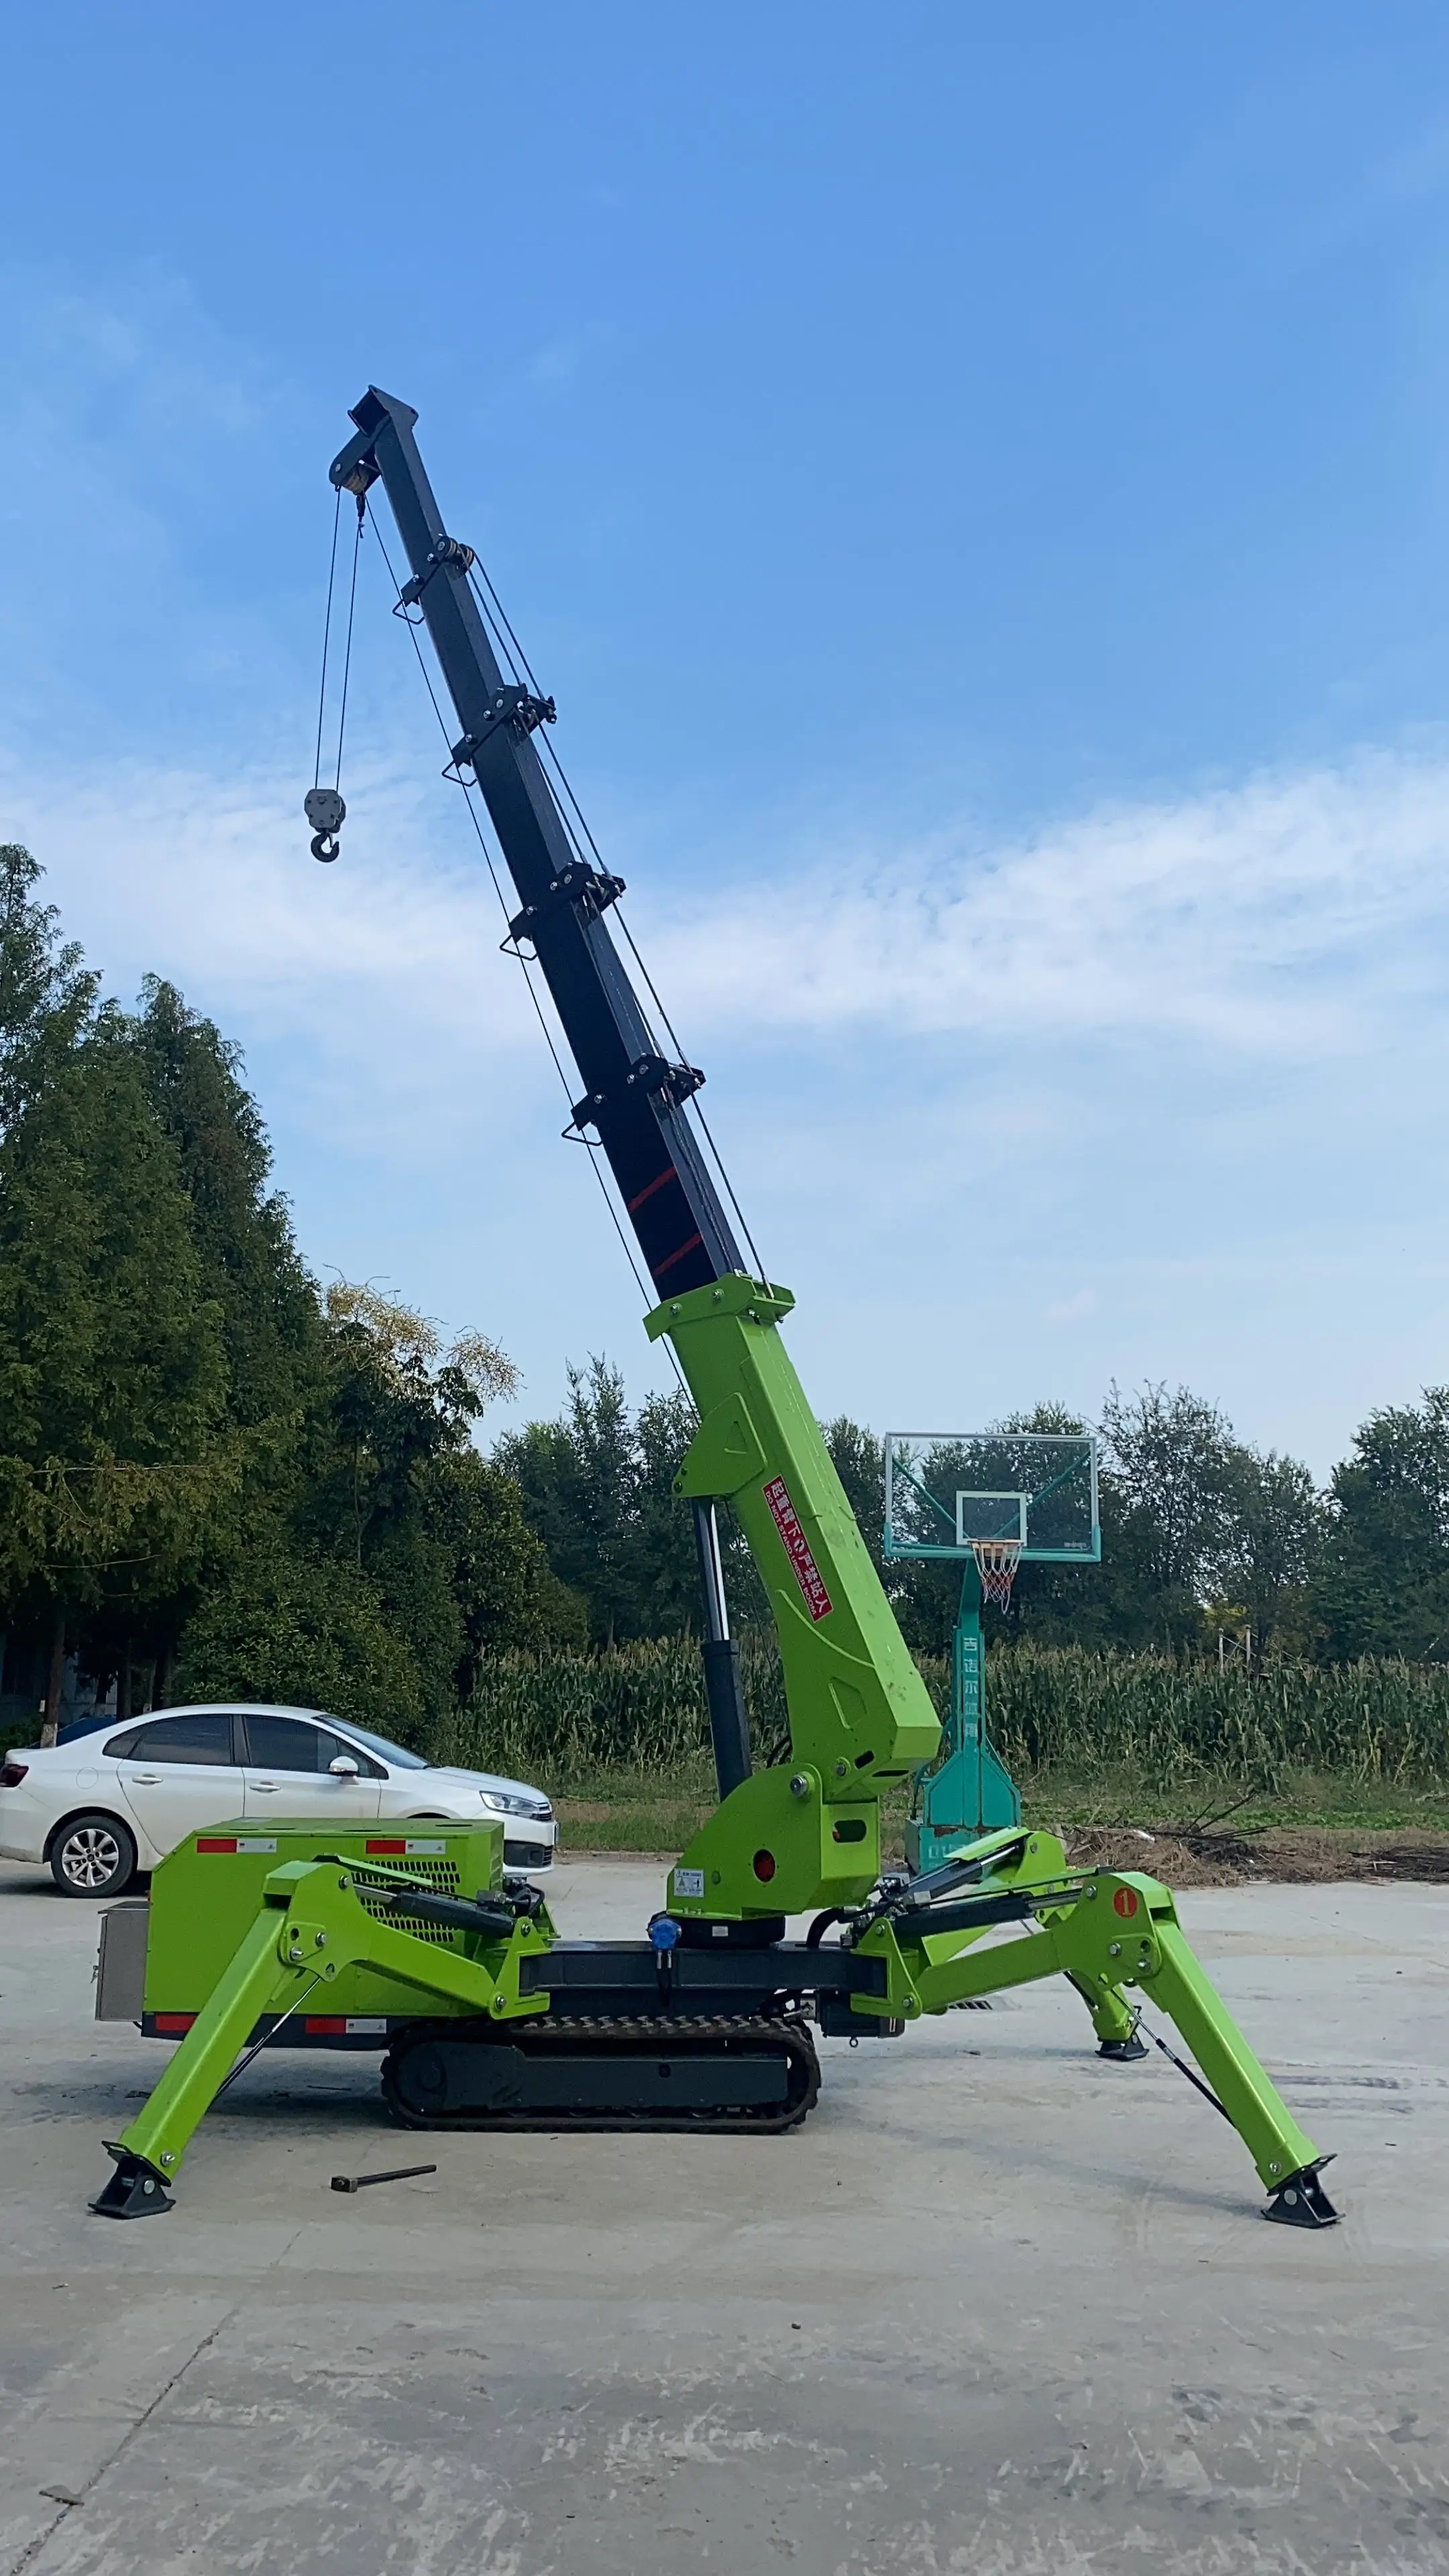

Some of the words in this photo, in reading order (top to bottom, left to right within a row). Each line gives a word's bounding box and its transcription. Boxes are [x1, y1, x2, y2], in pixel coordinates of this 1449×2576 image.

[766, 1491, 773, 1504] DO
[771, 1505, 782, 1523] NOT
[779, 1525, 792, 1554] STAND
[791, 1556, 805, 1587] UNDER
[803, 1587, 816, 1615] BOOM
[771, 1481, 800, 1536] 起重臂下
[798, 1552, 828, 1613] 严禁站人
[1120, 1890, 1133, 1915] 1
